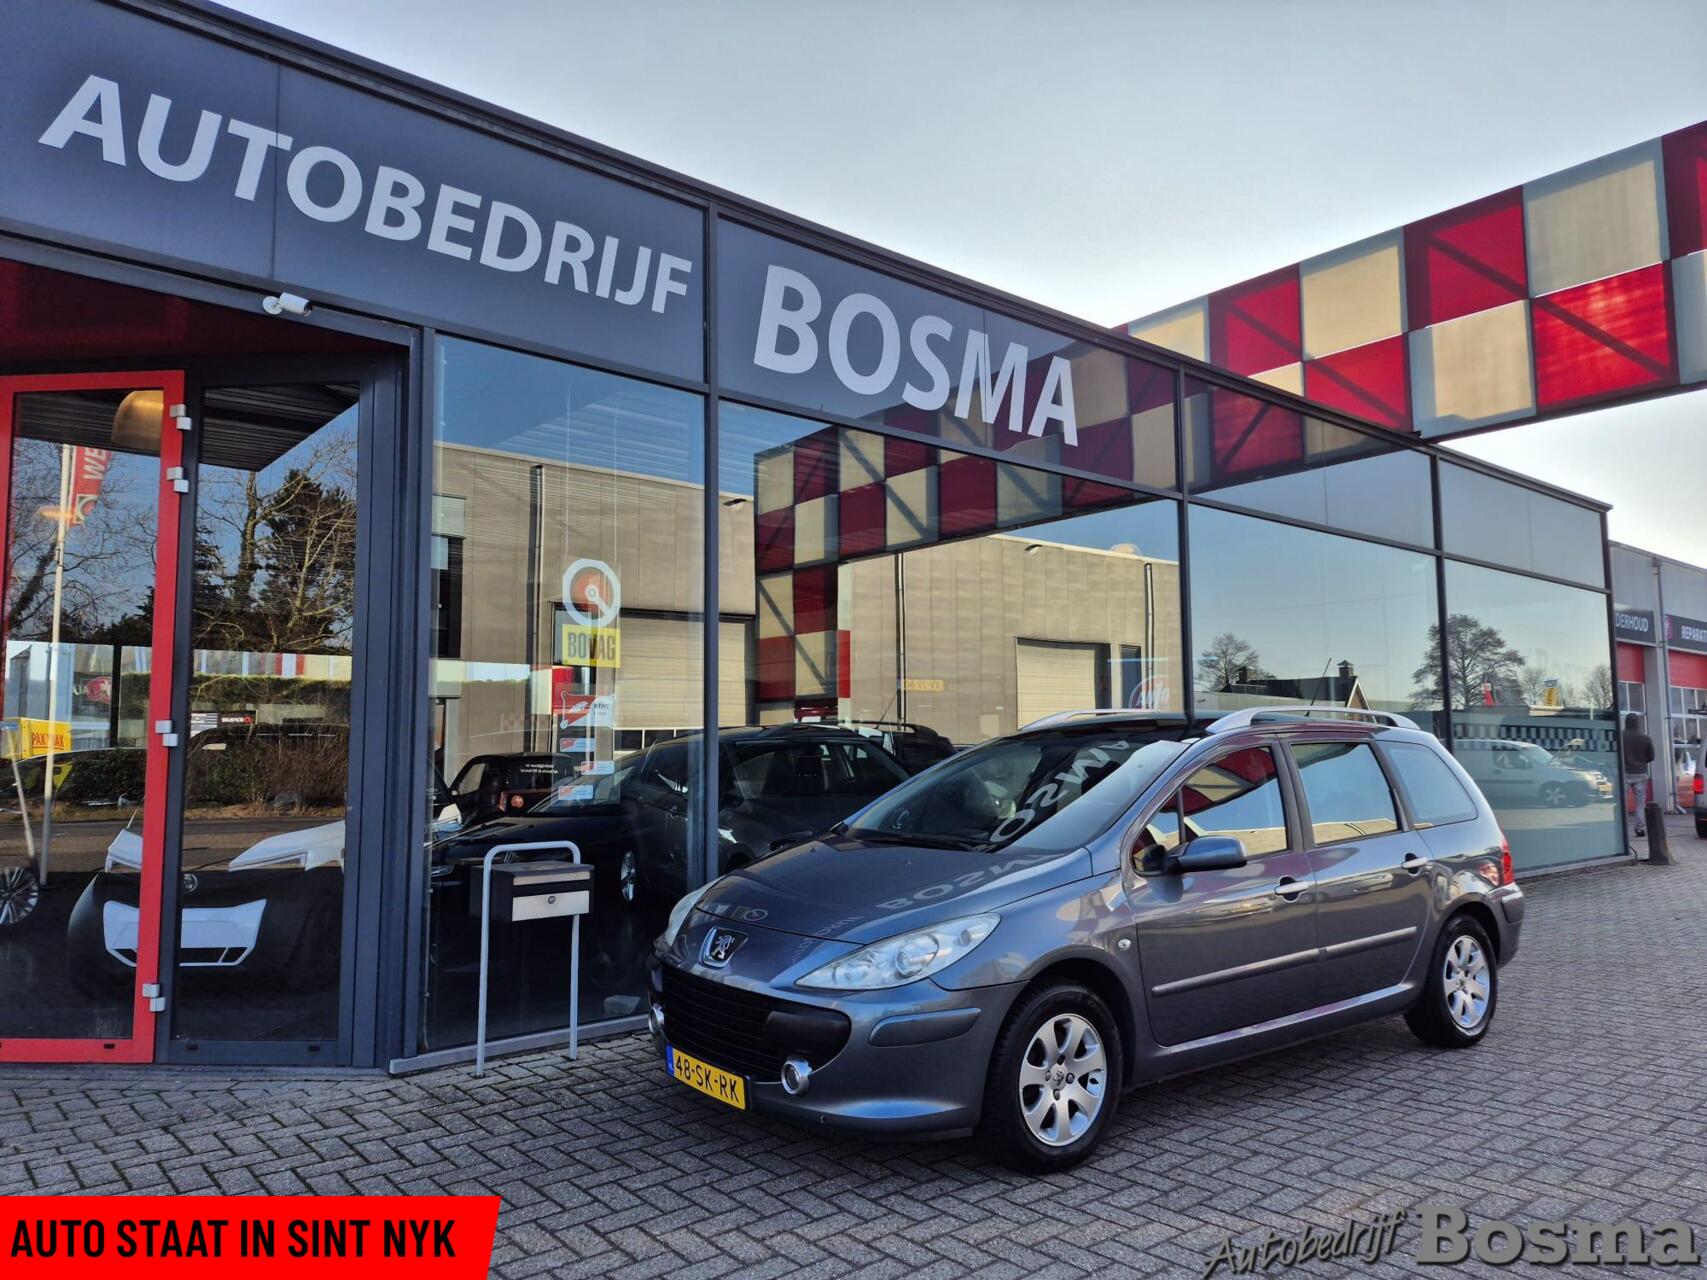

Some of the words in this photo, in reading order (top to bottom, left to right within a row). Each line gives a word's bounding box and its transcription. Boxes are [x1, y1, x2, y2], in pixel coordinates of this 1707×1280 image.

[38, 74, 692, 313] AUTOBEDRIJF
[753, 265, 1079, 447] BOSMA
[567, 631, 616, 661] BOVAG
[676, 1055, 739, 1104] 48-SK-RK
